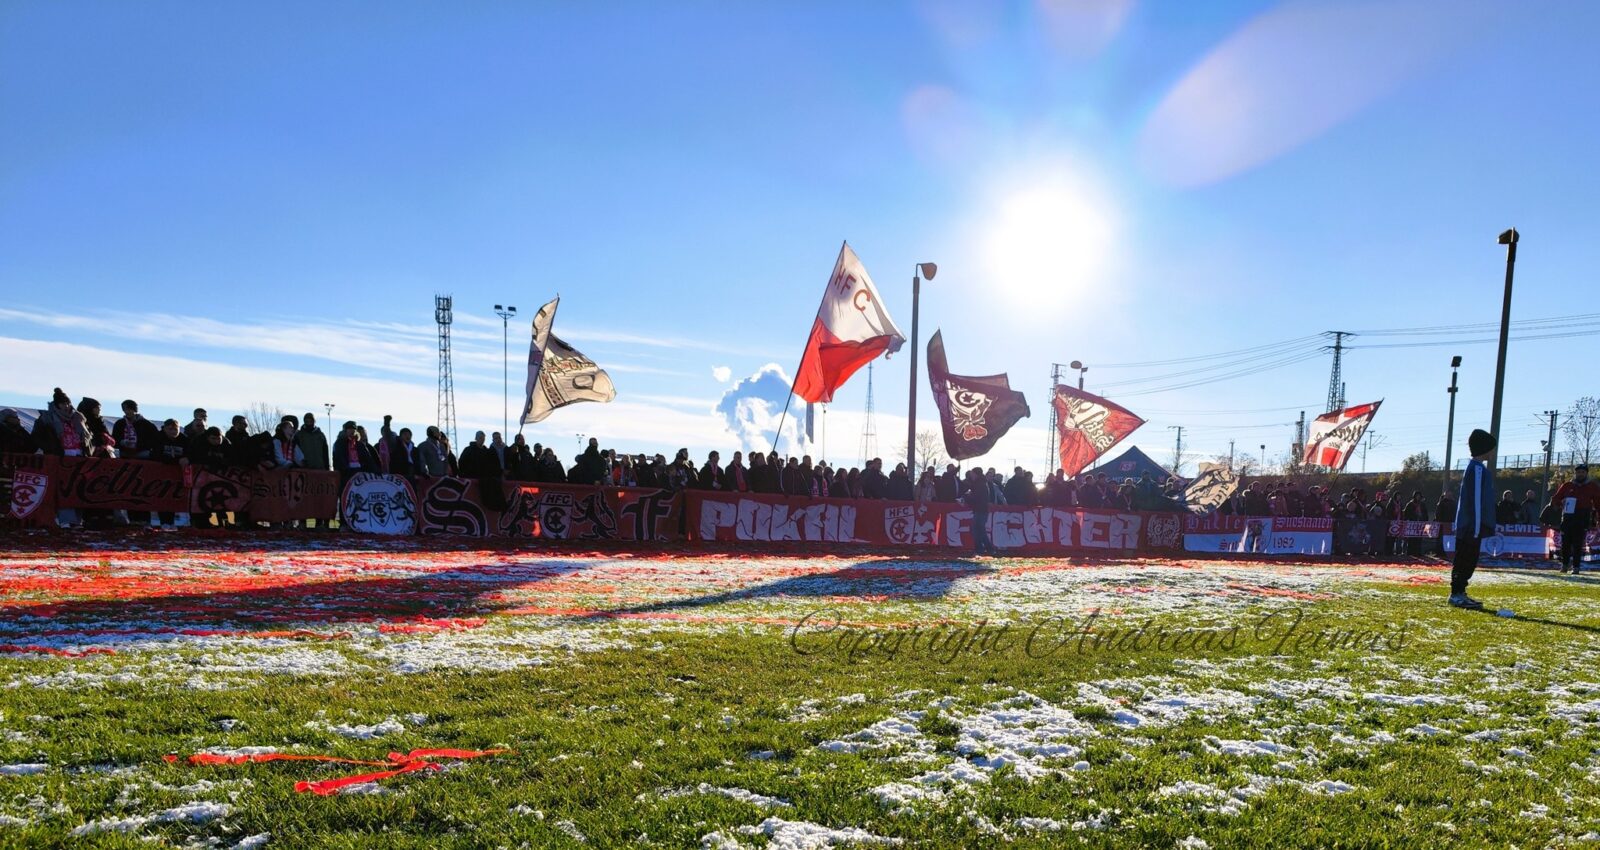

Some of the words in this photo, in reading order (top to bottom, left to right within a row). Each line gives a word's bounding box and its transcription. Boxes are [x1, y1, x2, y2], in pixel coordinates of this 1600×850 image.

[834, 268, 871, 312] HFC
[15, 472, 41, 484] HFC
[545, 493, 570, 505] HFC
[889, 507, 909, 517] HFC
[700, 499, 860, 542] POKAL
[1272, 537, 1296, 549] 1982
